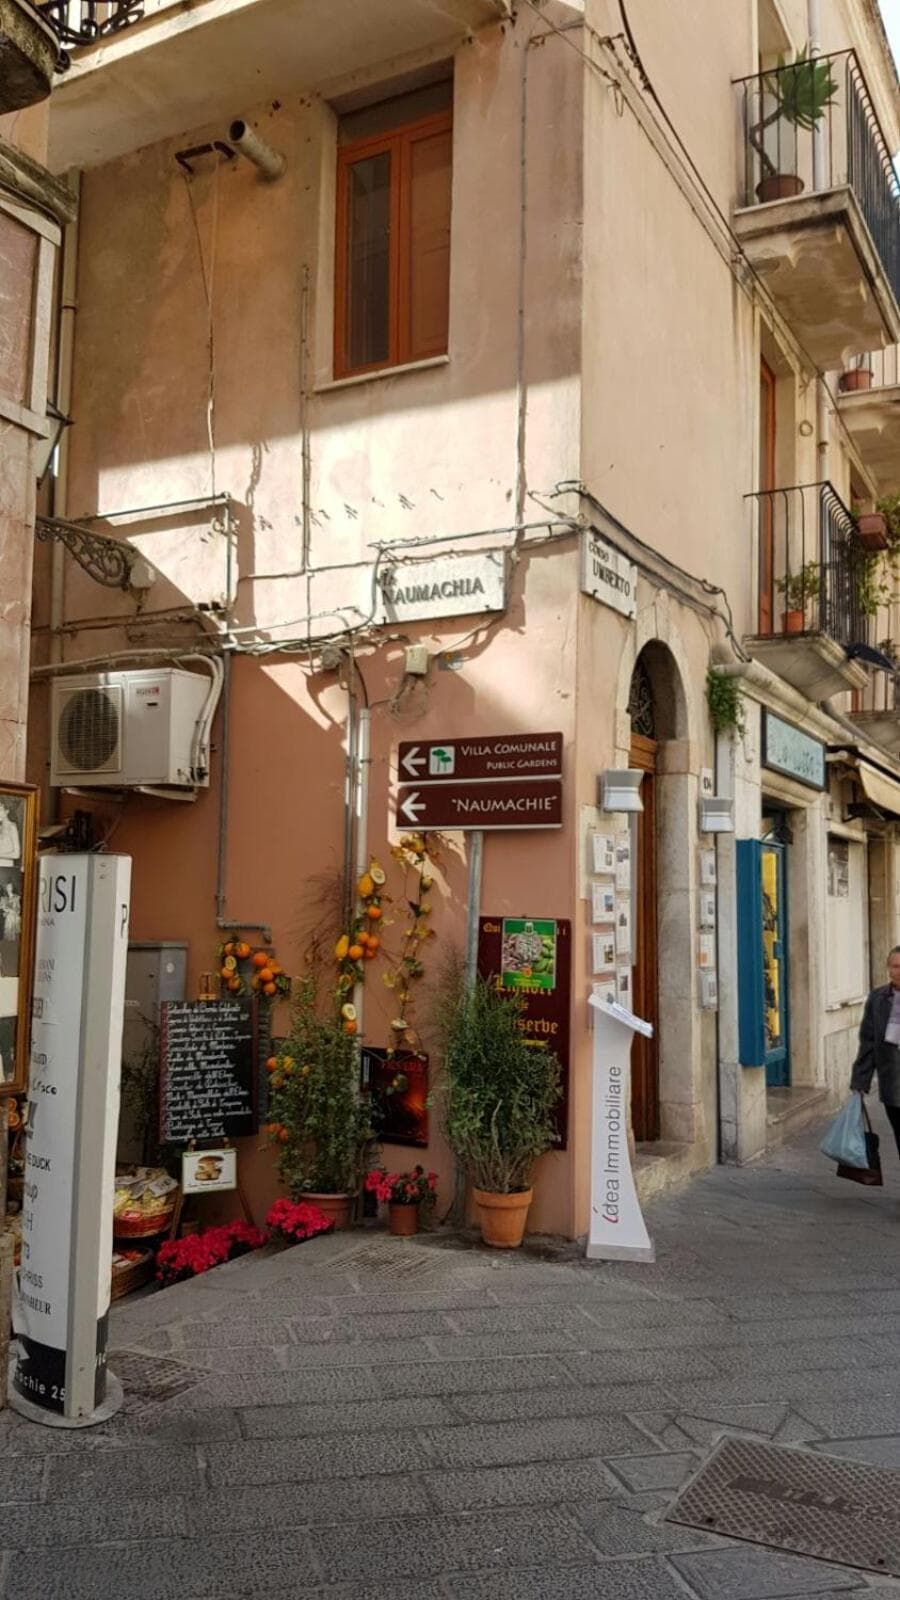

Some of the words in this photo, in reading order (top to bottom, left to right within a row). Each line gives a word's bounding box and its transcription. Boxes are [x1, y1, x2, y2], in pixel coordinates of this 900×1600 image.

[592, 558, 630, 597] UMBERTO
[382, 577, 485, 606] NAUMACHIA
[461, 745, 491, 756] VILLA
[494, 741, 557, 754] COMUNALE
[487, 760, 516, 769] PUBLIC
[517, 758, 557, 768] GARDENS
[603, 1066, 622, 1174] Immobiliare
[51, 1385, 66, 1402] 25
